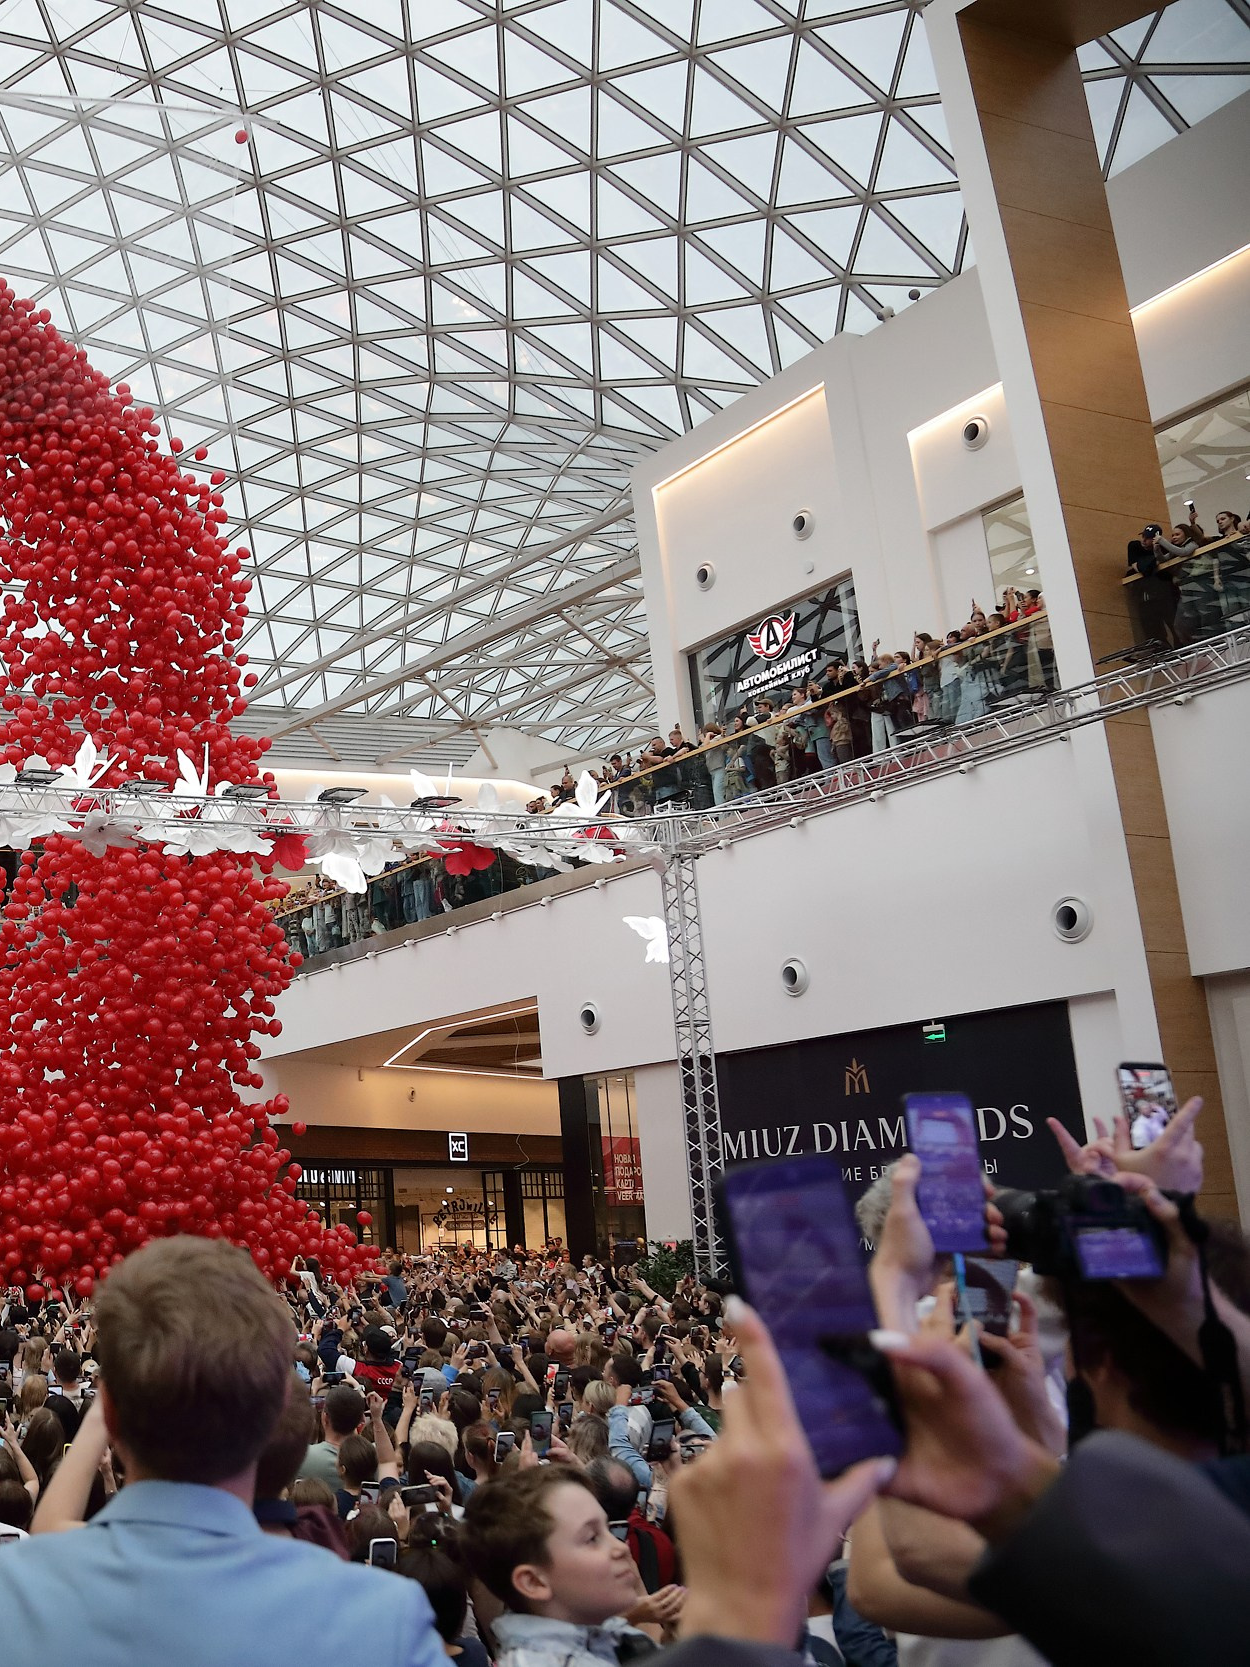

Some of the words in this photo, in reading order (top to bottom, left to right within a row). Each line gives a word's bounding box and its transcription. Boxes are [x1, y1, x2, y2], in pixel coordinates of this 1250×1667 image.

[737, 648, 818, 692] АВТОМОБИЛИСТ
[748, 673, 789, 697] хоккейный
[791, 665, 811, 679] клуб
[723, 1125, 804, 1160] MIUZ
[812, 1104, 1034, 1154] DIAMDS
[377, 1377, 394, 1385] СССР
